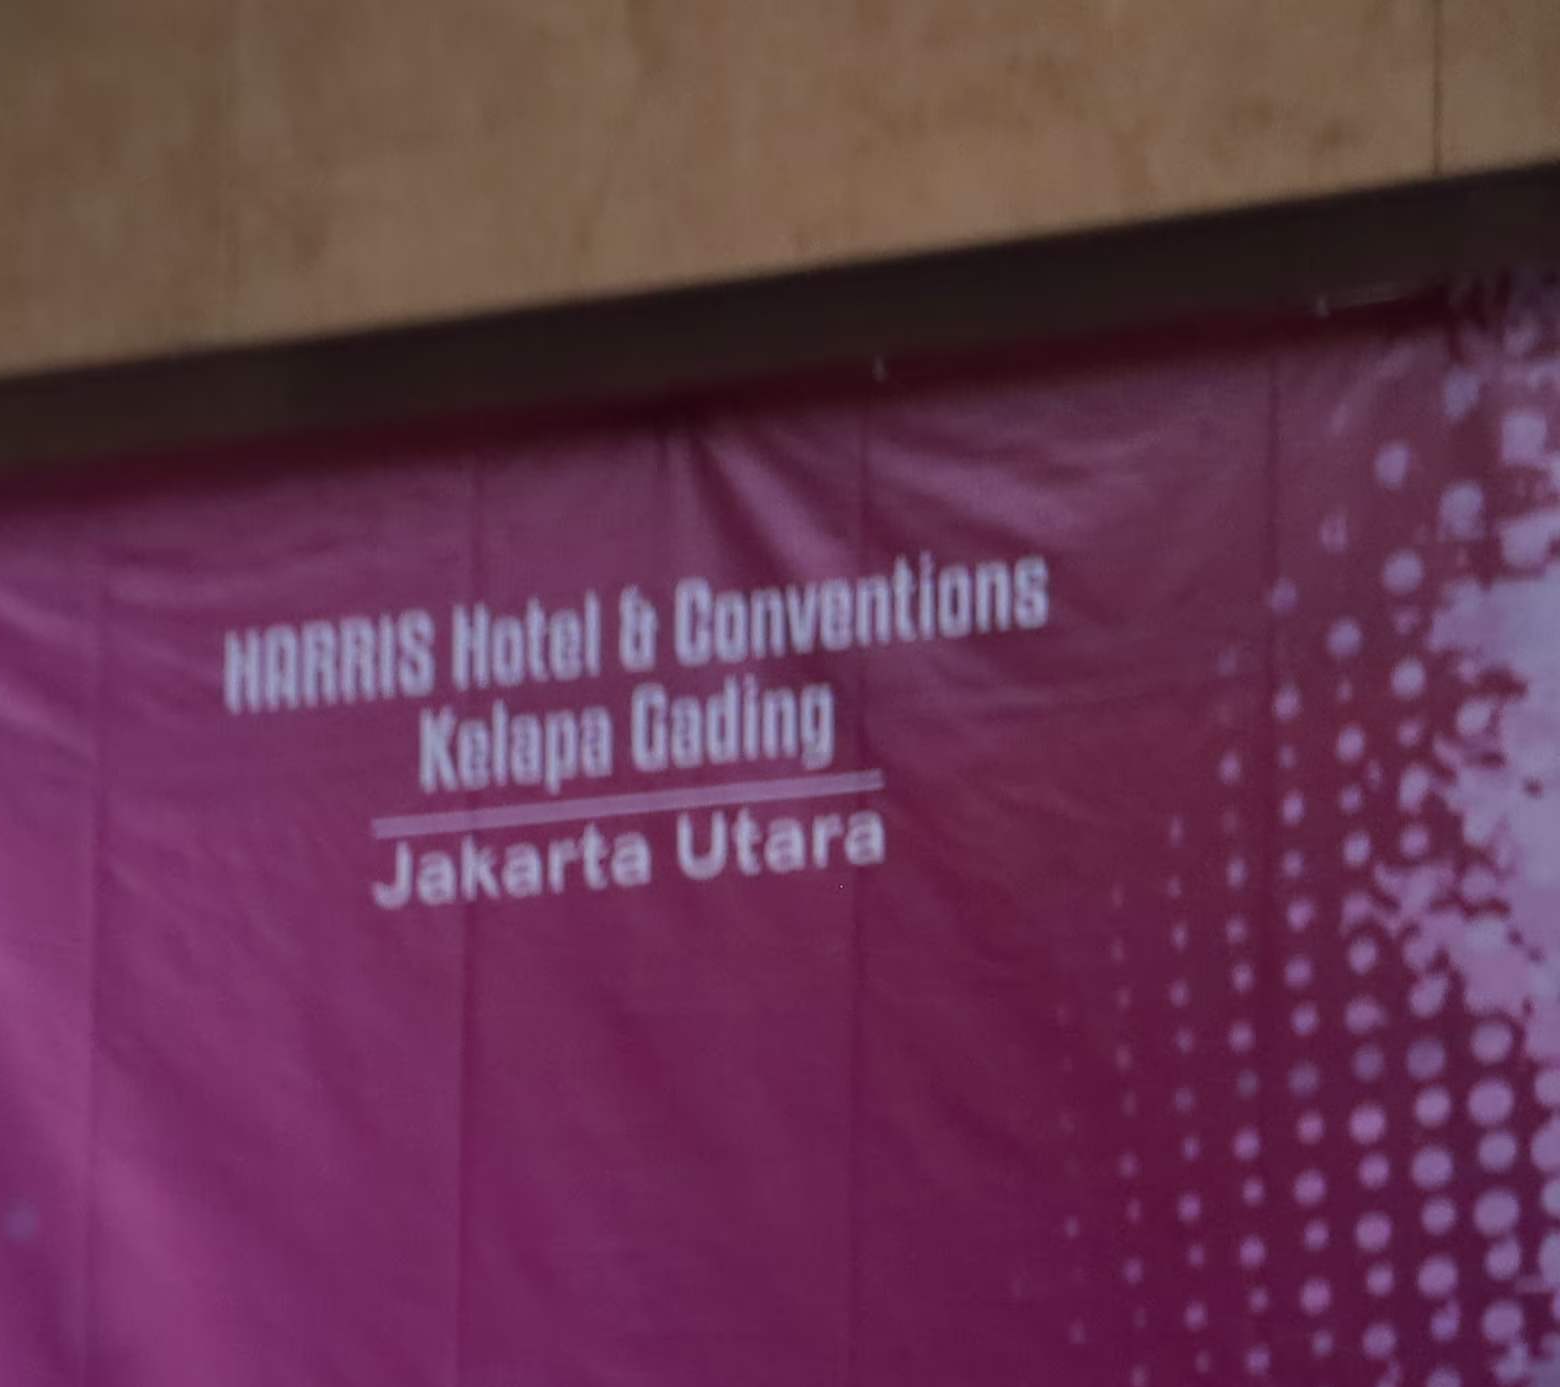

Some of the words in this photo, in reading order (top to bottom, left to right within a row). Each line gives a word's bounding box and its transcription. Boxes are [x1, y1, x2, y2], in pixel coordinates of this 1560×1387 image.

[224, 612, 434, 712] HARRIS
[453, 597, 601, 690] Hotel
[620, 589, 656, 666] &
[674, 557, 1050, 661] Conventions
[418, 704, 612, 792] Kelapa
[631, 680, 834, 769] Gading
[372, 831, 651, 905] Jakarta
[678, 810, 884, 877] Utara
